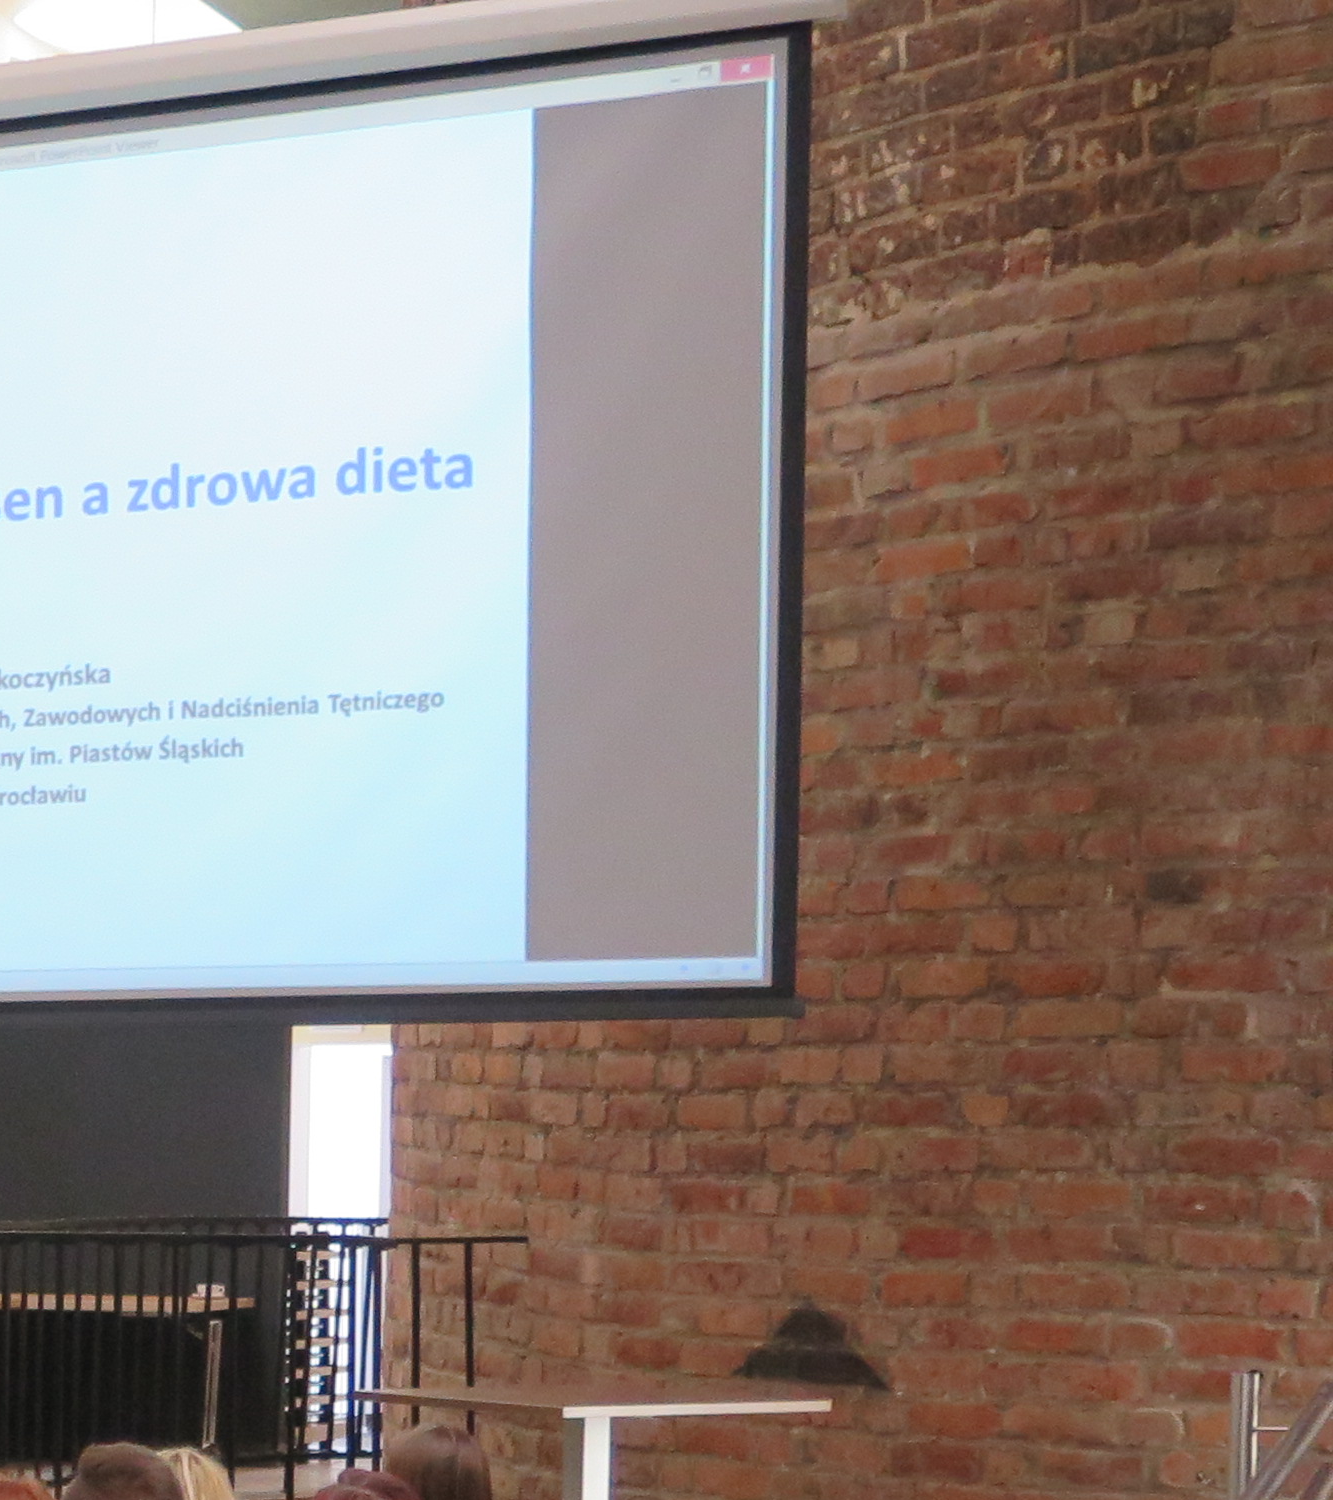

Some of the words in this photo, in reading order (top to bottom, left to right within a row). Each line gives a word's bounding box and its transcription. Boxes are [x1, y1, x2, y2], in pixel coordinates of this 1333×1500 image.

[81, 481, 110, 516] a
[126, 462, 317, 513] zdrowa
[335, 445, 474, 497] dieta
[23, 700, 161, 728] Zawodowych
[168, 699, 175, 721] i
[180, 694, 320, 720] Nadciśnienia
[326, 689, 446, 718] Tętniczego
[29, 745, 63, 766] im.
[69, 740, 154, 764] Piastów
[158, 734, 244, 764] Śląskich
